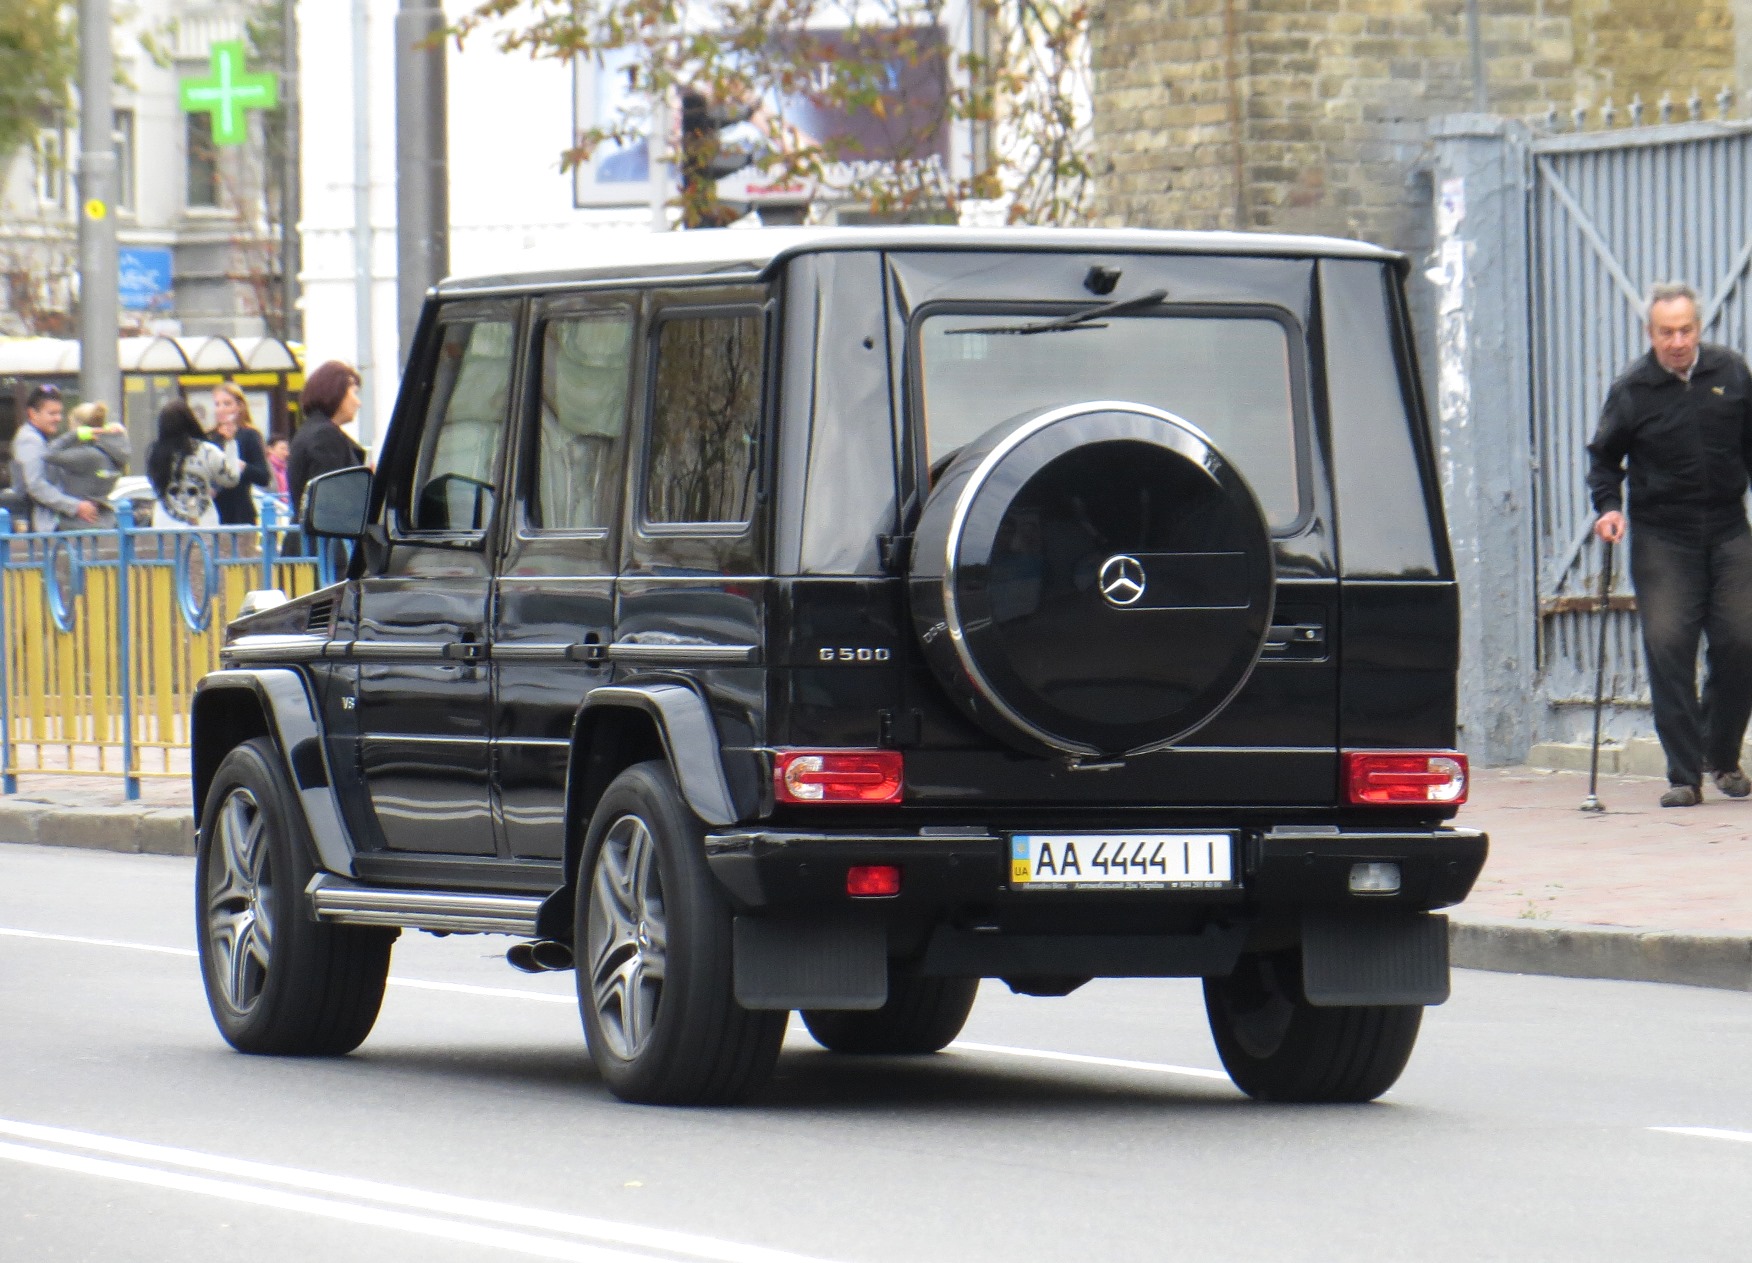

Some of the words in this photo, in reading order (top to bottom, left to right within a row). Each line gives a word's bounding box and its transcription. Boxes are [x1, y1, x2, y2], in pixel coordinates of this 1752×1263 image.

[819, 647, 891, 661] G500
[1035, 841, 1082, 876] AA
[1091, 841, 1167, 875] 4444
[1014, 867, 1029, 877] UA
